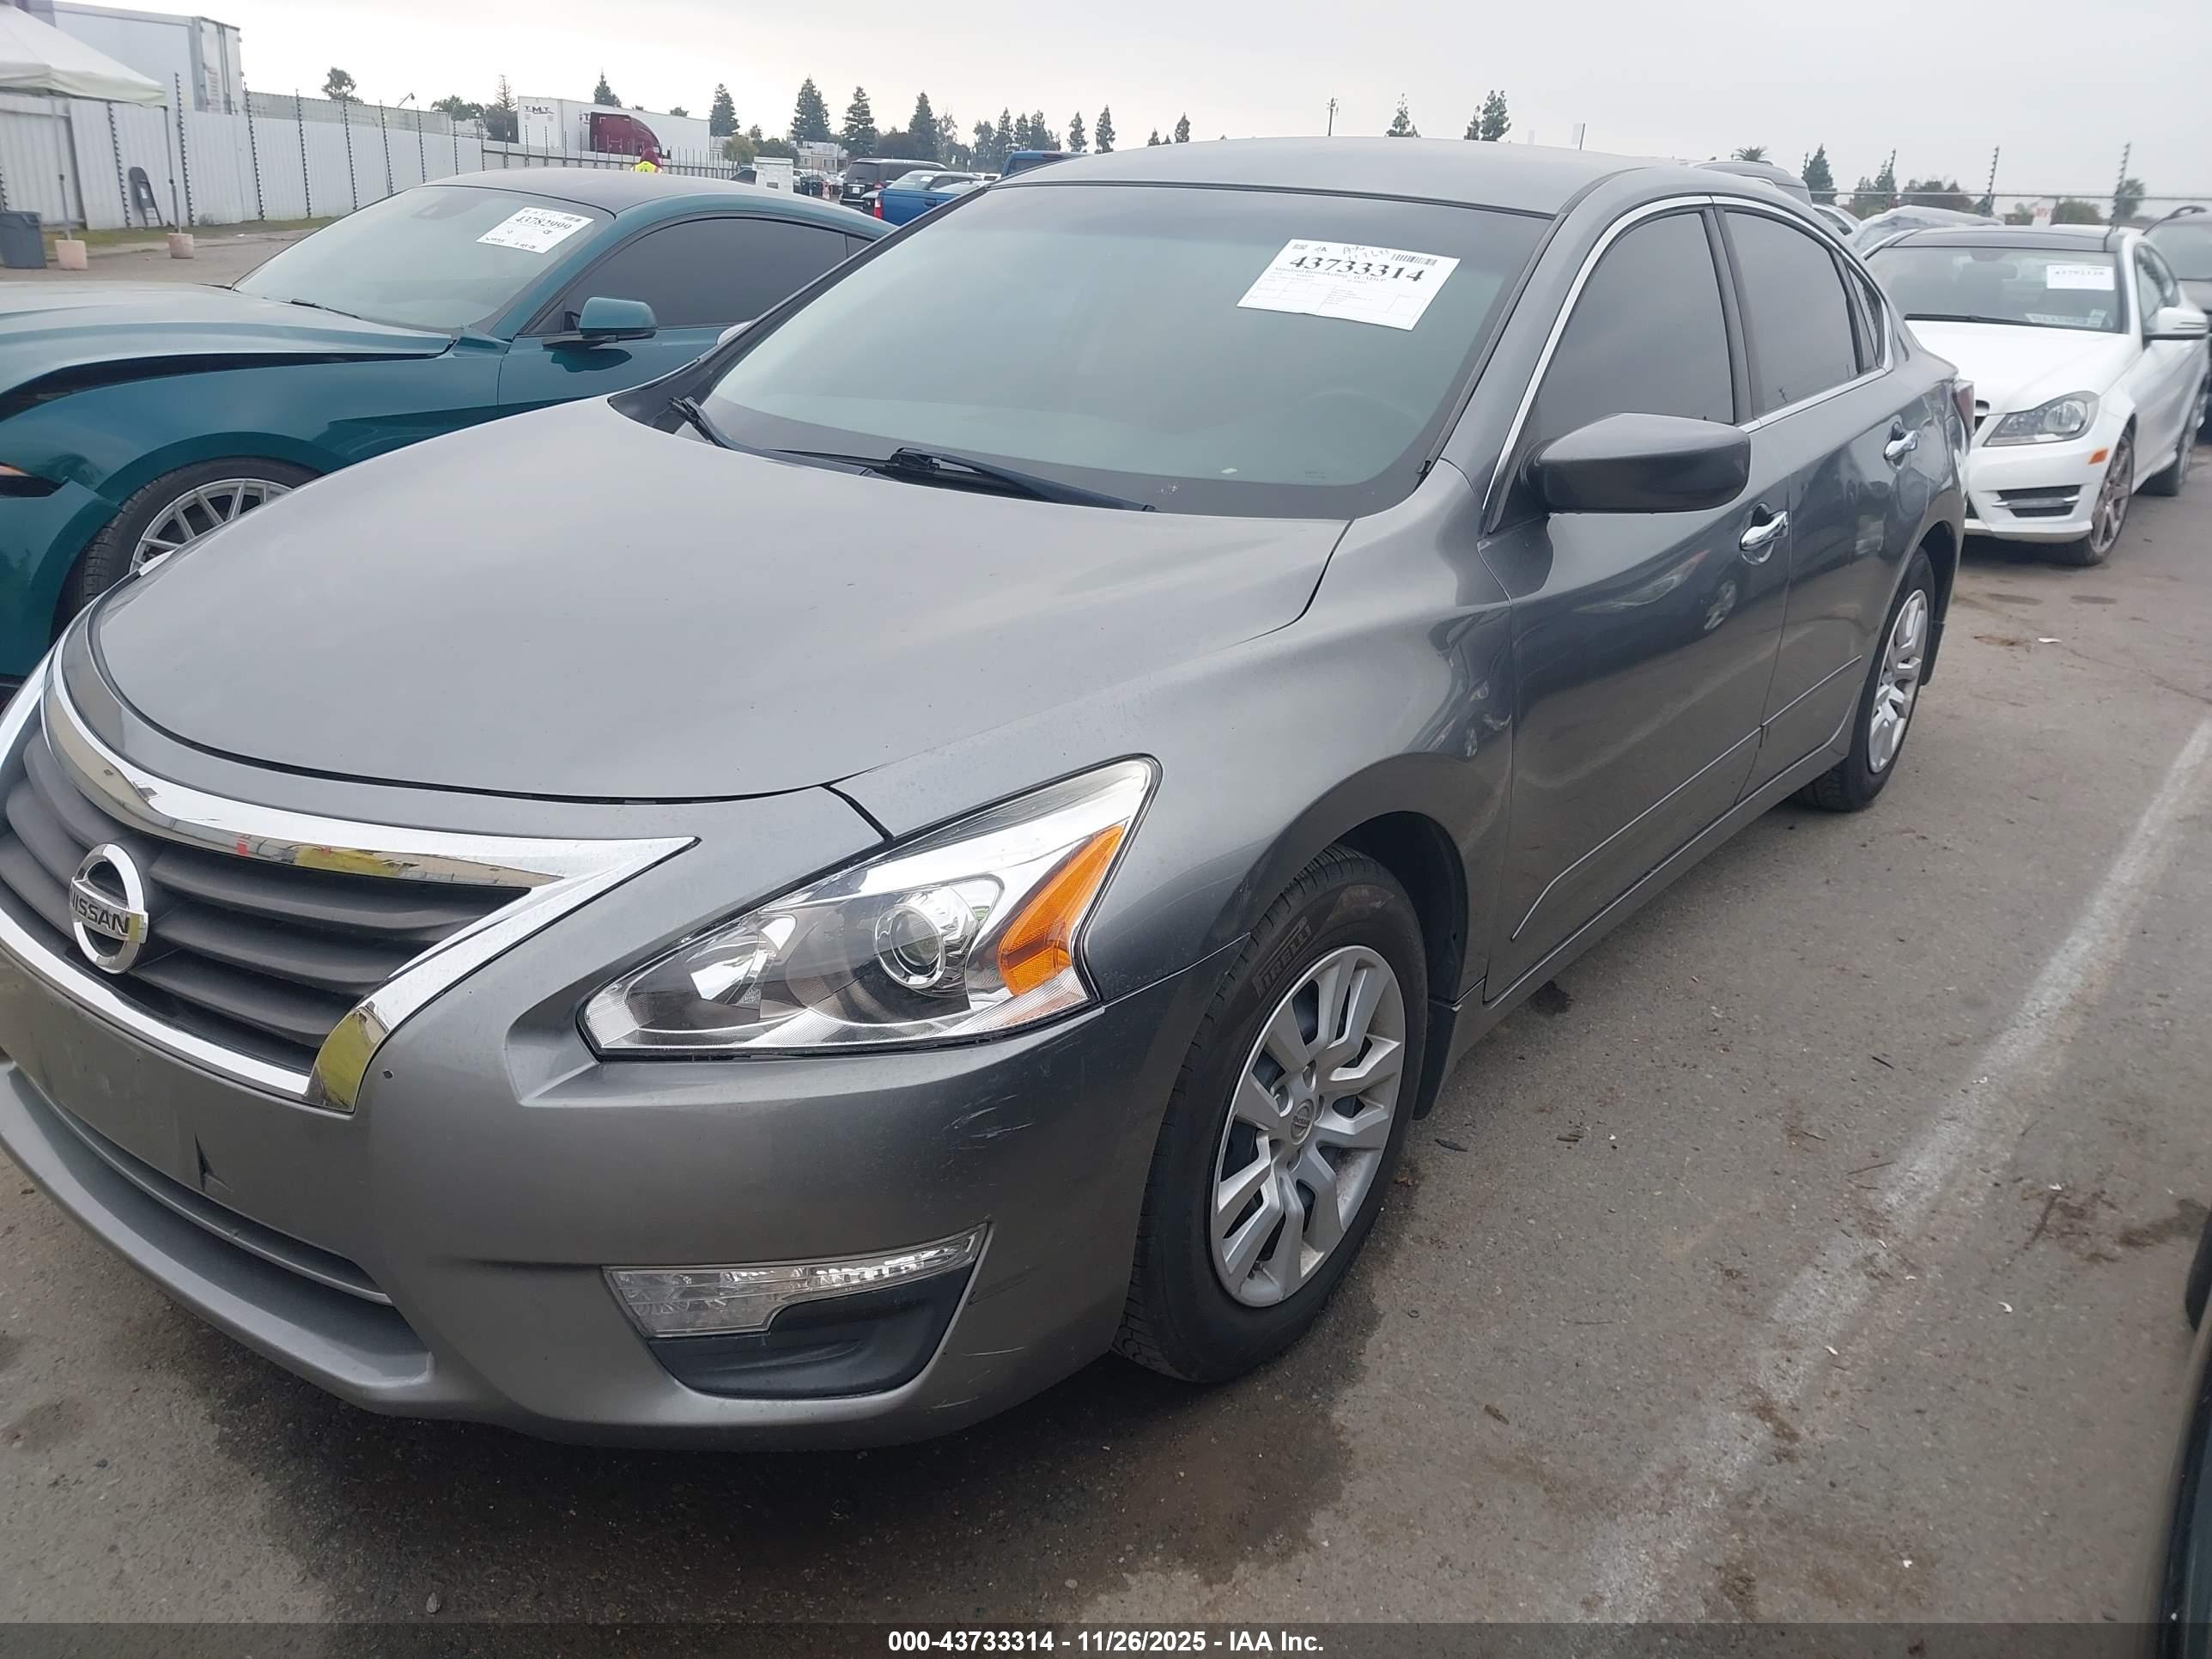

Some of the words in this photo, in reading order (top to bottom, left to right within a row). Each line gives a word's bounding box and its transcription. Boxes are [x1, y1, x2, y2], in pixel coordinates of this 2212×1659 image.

[1289, 255, 1425, 283] 43733314
[70, 890, 131, 934] NISSAN
[1251, 915, 1312, 1000] PIRELLI
